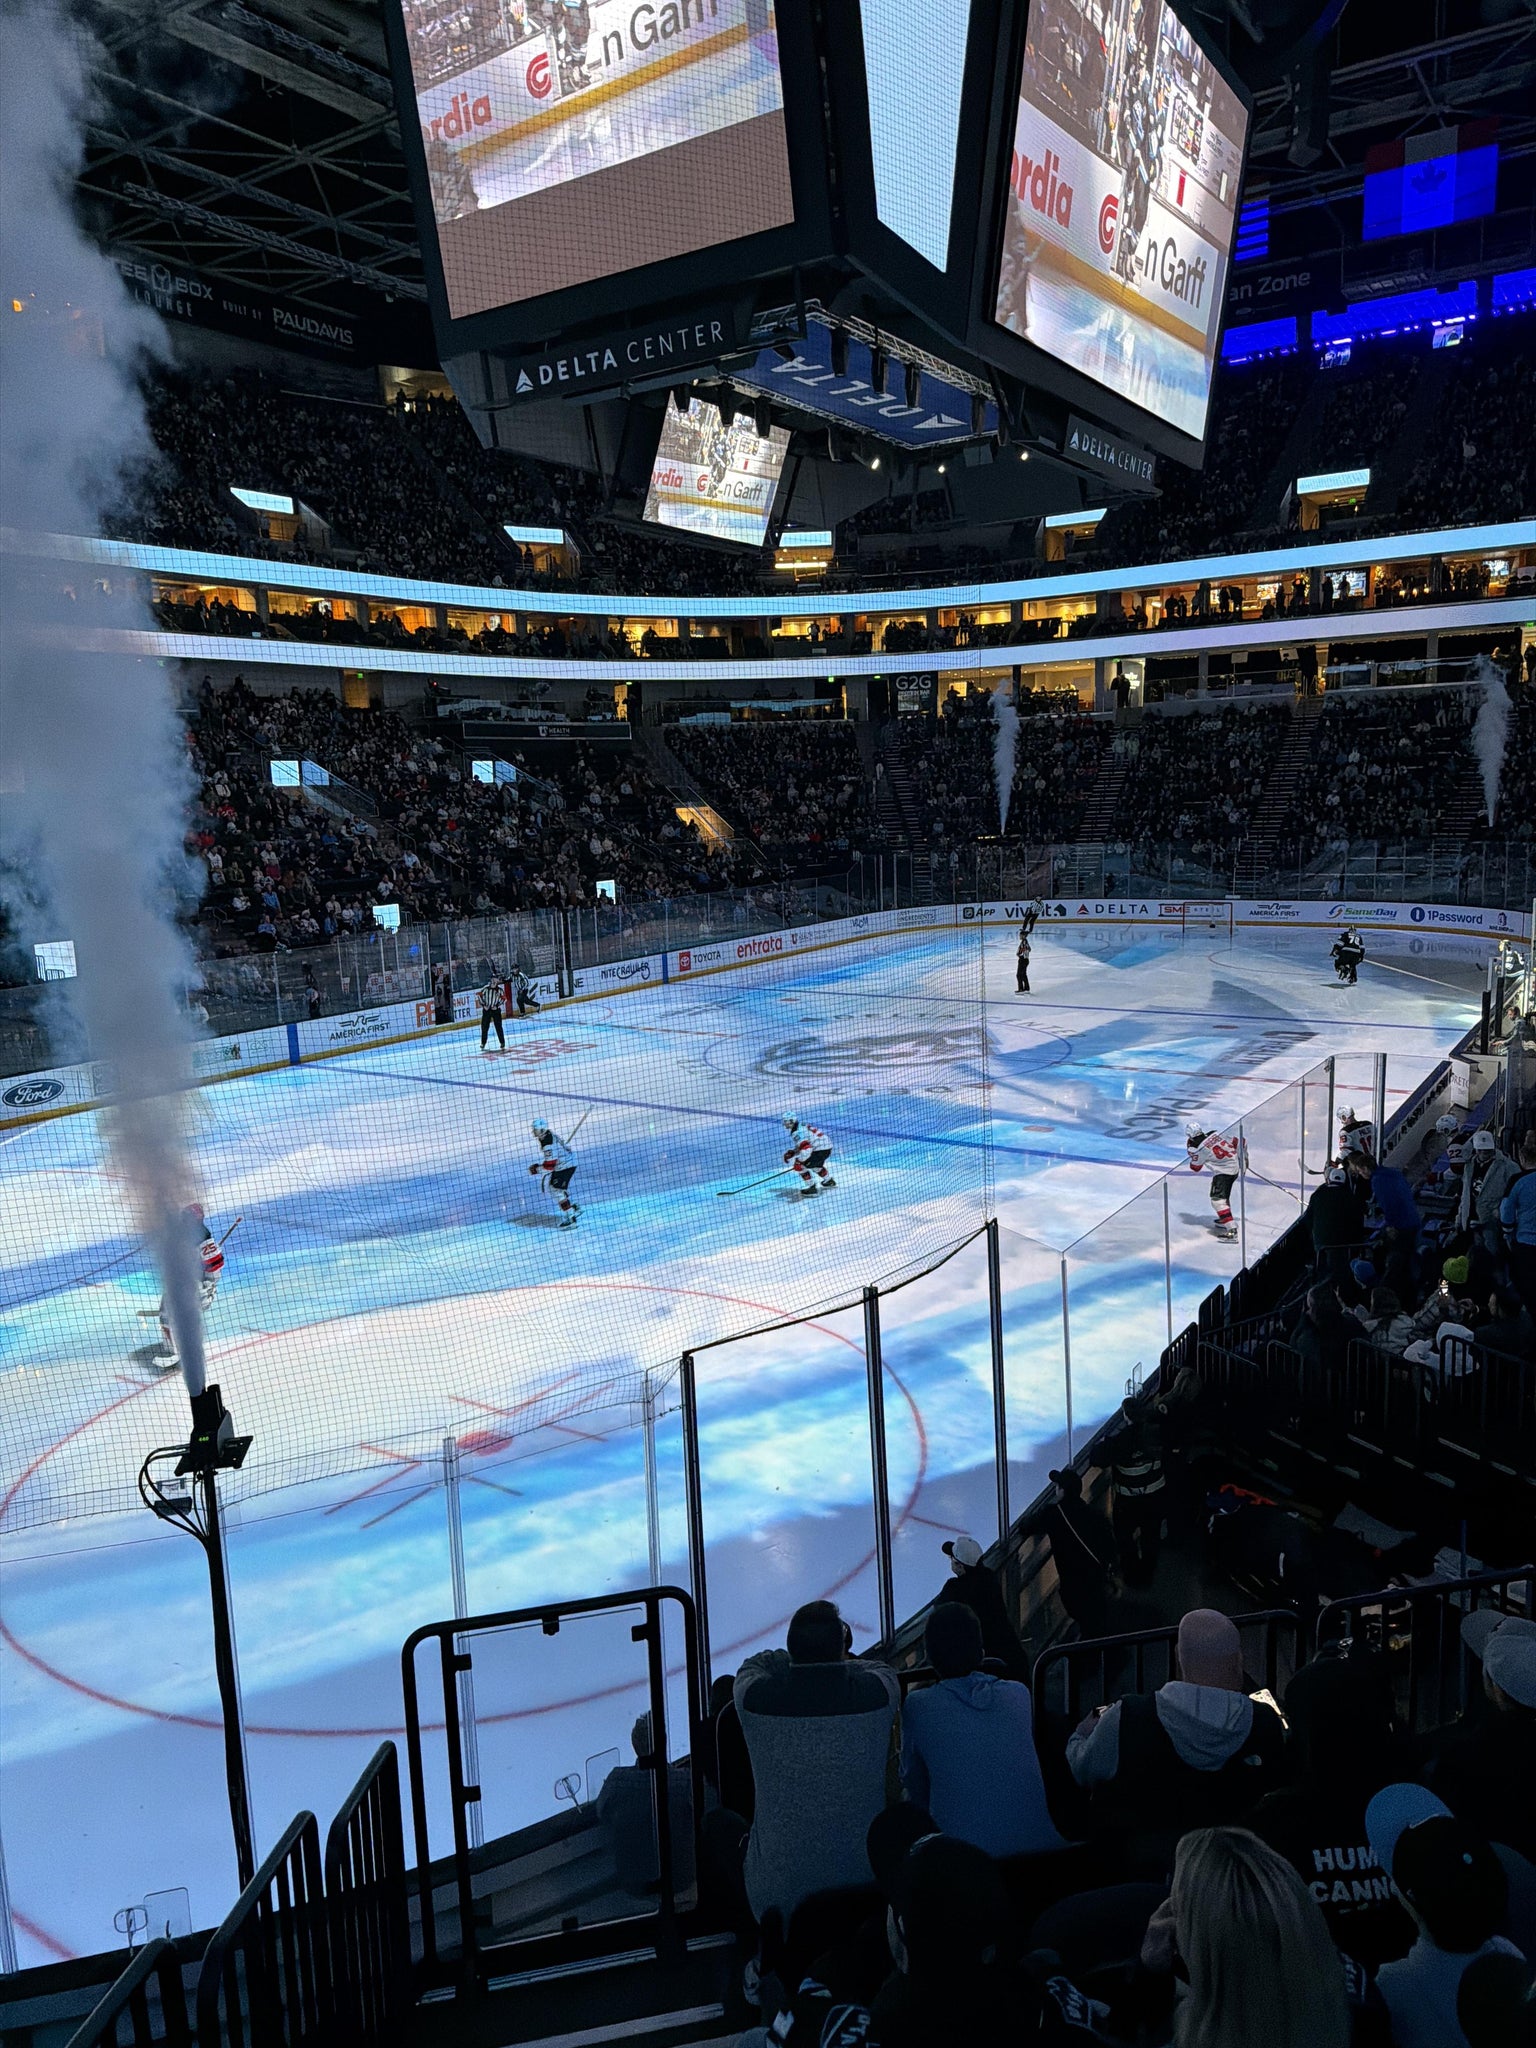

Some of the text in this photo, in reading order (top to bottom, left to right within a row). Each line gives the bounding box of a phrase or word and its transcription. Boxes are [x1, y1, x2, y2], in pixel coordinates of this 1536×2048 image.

[1160, 237, 1207, 309] Garff
[175, 277, 213, 300] BOX
[1257, 271, 1311, 296] Zone
[135, 288, 192, 317] LOUNGE
[538, 321, 724, 386] DELTA CENTER
[770, 356, 925, 418] DELTA
[1081, 432, 1152, 480] DELTA CENTER
[734, 481, 763, 500] Garff
[896, 675, 931, 690] G2G
[1095, 904, 1149, 915] DELTA
[1164, 906, 1190, 914] SME
[1344, 907, 1398, 918] SameDay
[1427, 910, 1483, 925] 1Password
[693, 950, 721, 963] TOYOTA
[737, 936, 782, 958] entrata
[330, 1025, 367, 1041] AMERICA
[367, 1022, 390, 1033] FIRST
[14, 1083, 53, 1103] Ford
[1448, 1149, 1462, 1159] 22
[202, 1243, 217, 1256] 25
[1312, 1846, 1378, 1872] HUM
